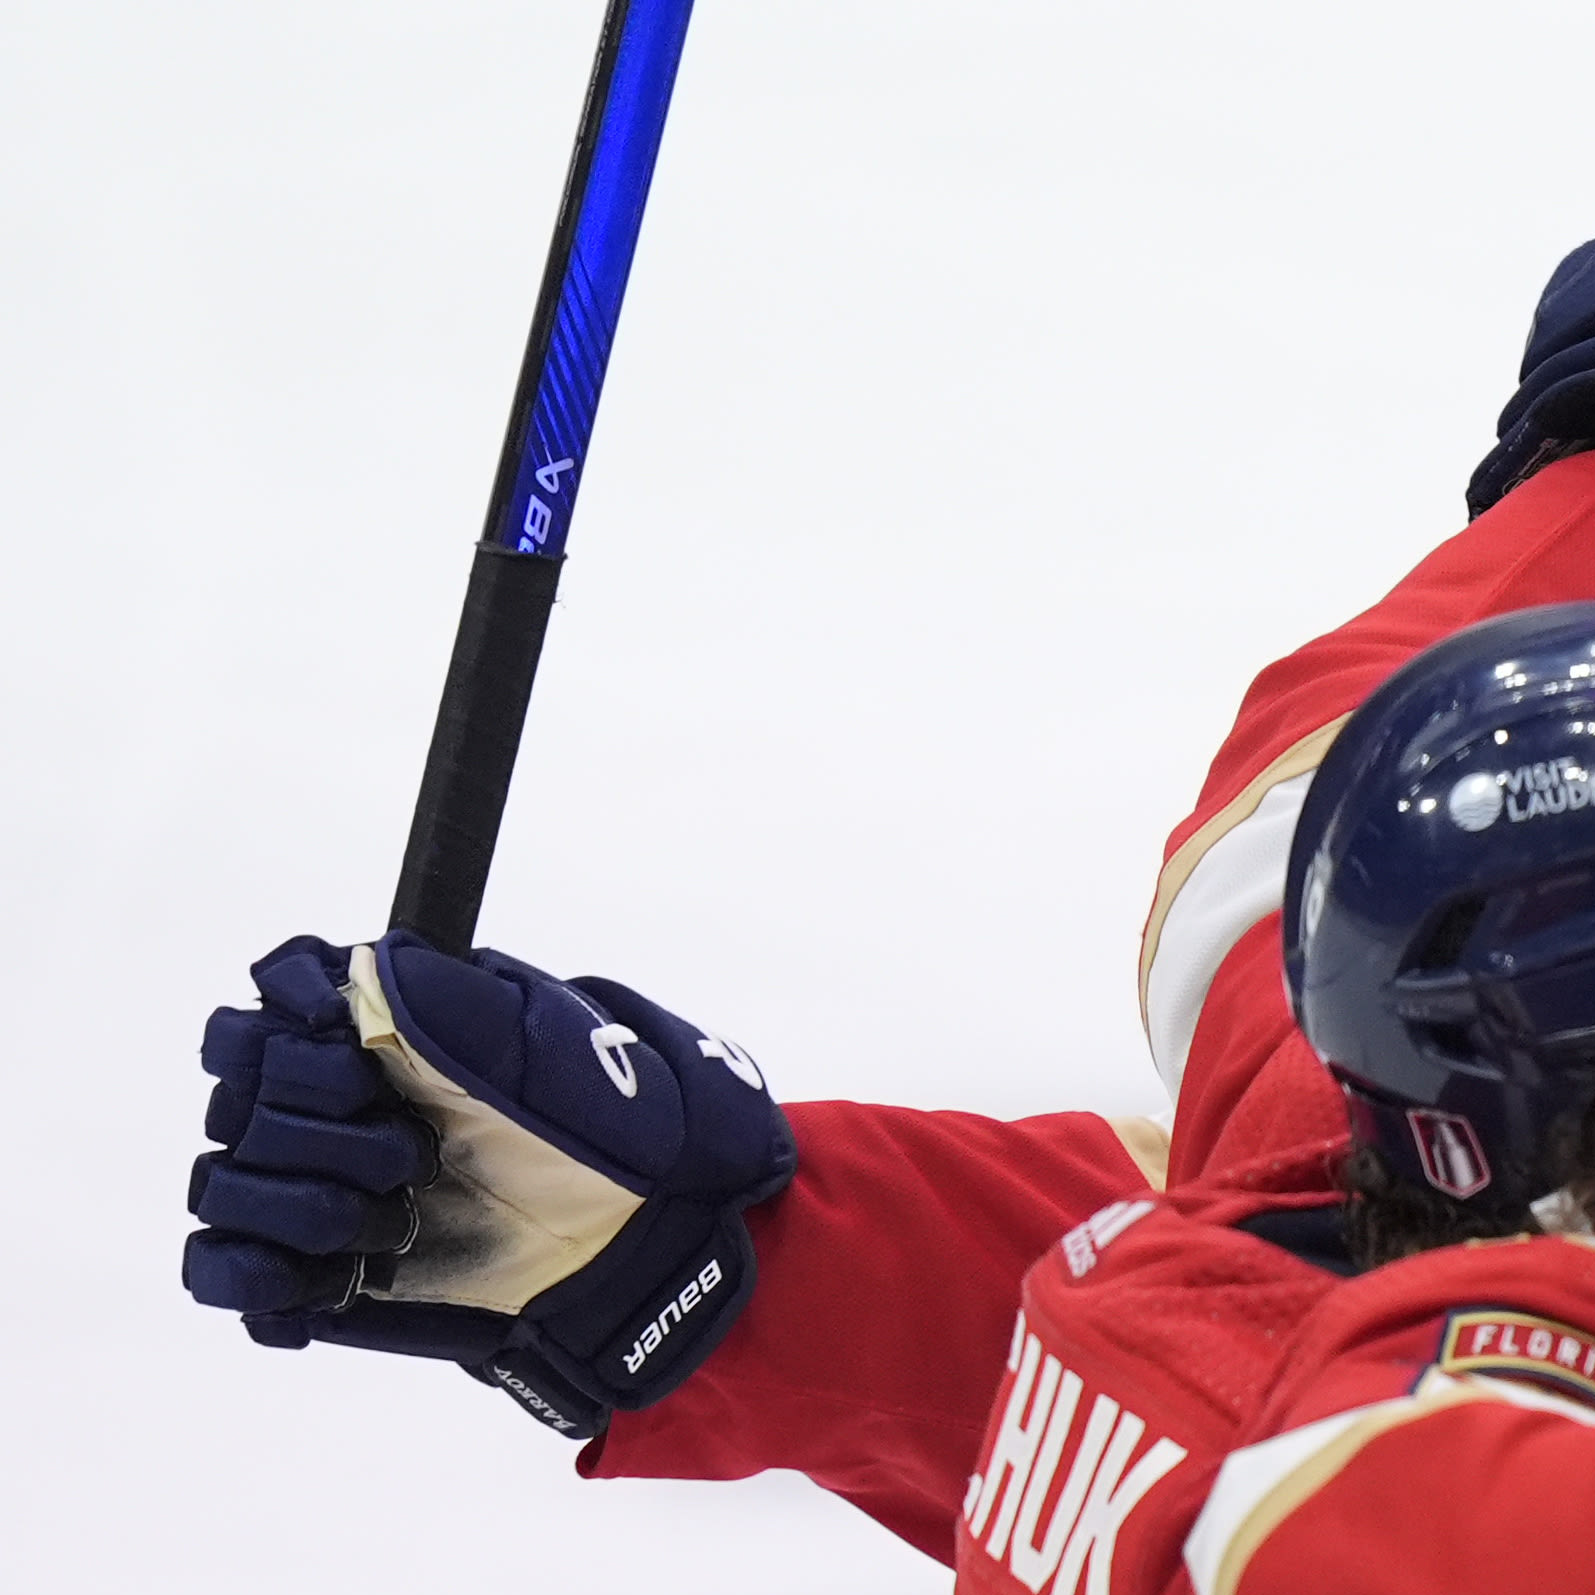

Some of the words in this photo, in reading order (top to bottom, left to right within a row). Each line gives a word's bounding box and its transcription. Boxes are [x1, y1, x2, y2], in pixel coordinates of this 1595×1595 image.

[1502, 756, 1582, 796] VISIT
[623, 1258, 723, 1375] BAUER
[493, 1363, 576, 1433] BARKOV
